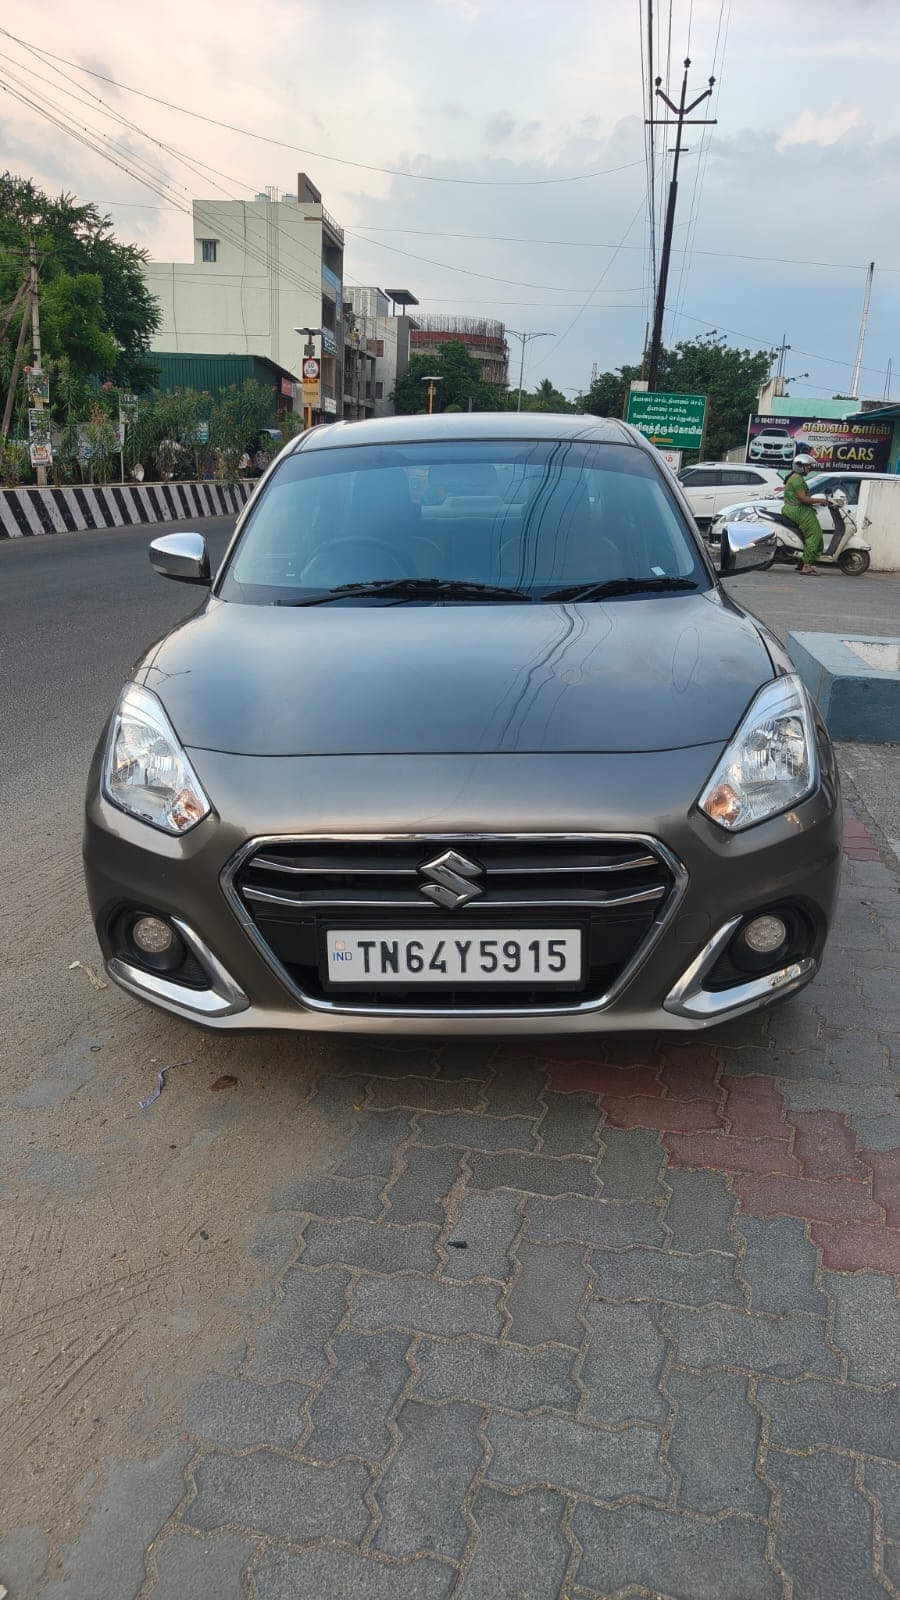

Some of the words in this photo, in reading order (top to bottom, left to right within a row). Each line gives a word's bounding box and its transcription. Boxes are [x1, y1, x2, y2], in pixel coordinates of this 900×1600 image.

[812, 445, 833, 459] SM
[837, 446, 875, 461] CARS
[332, 951, 353, 962] IND
[357, 939, 567, 974] TN64Y5915
